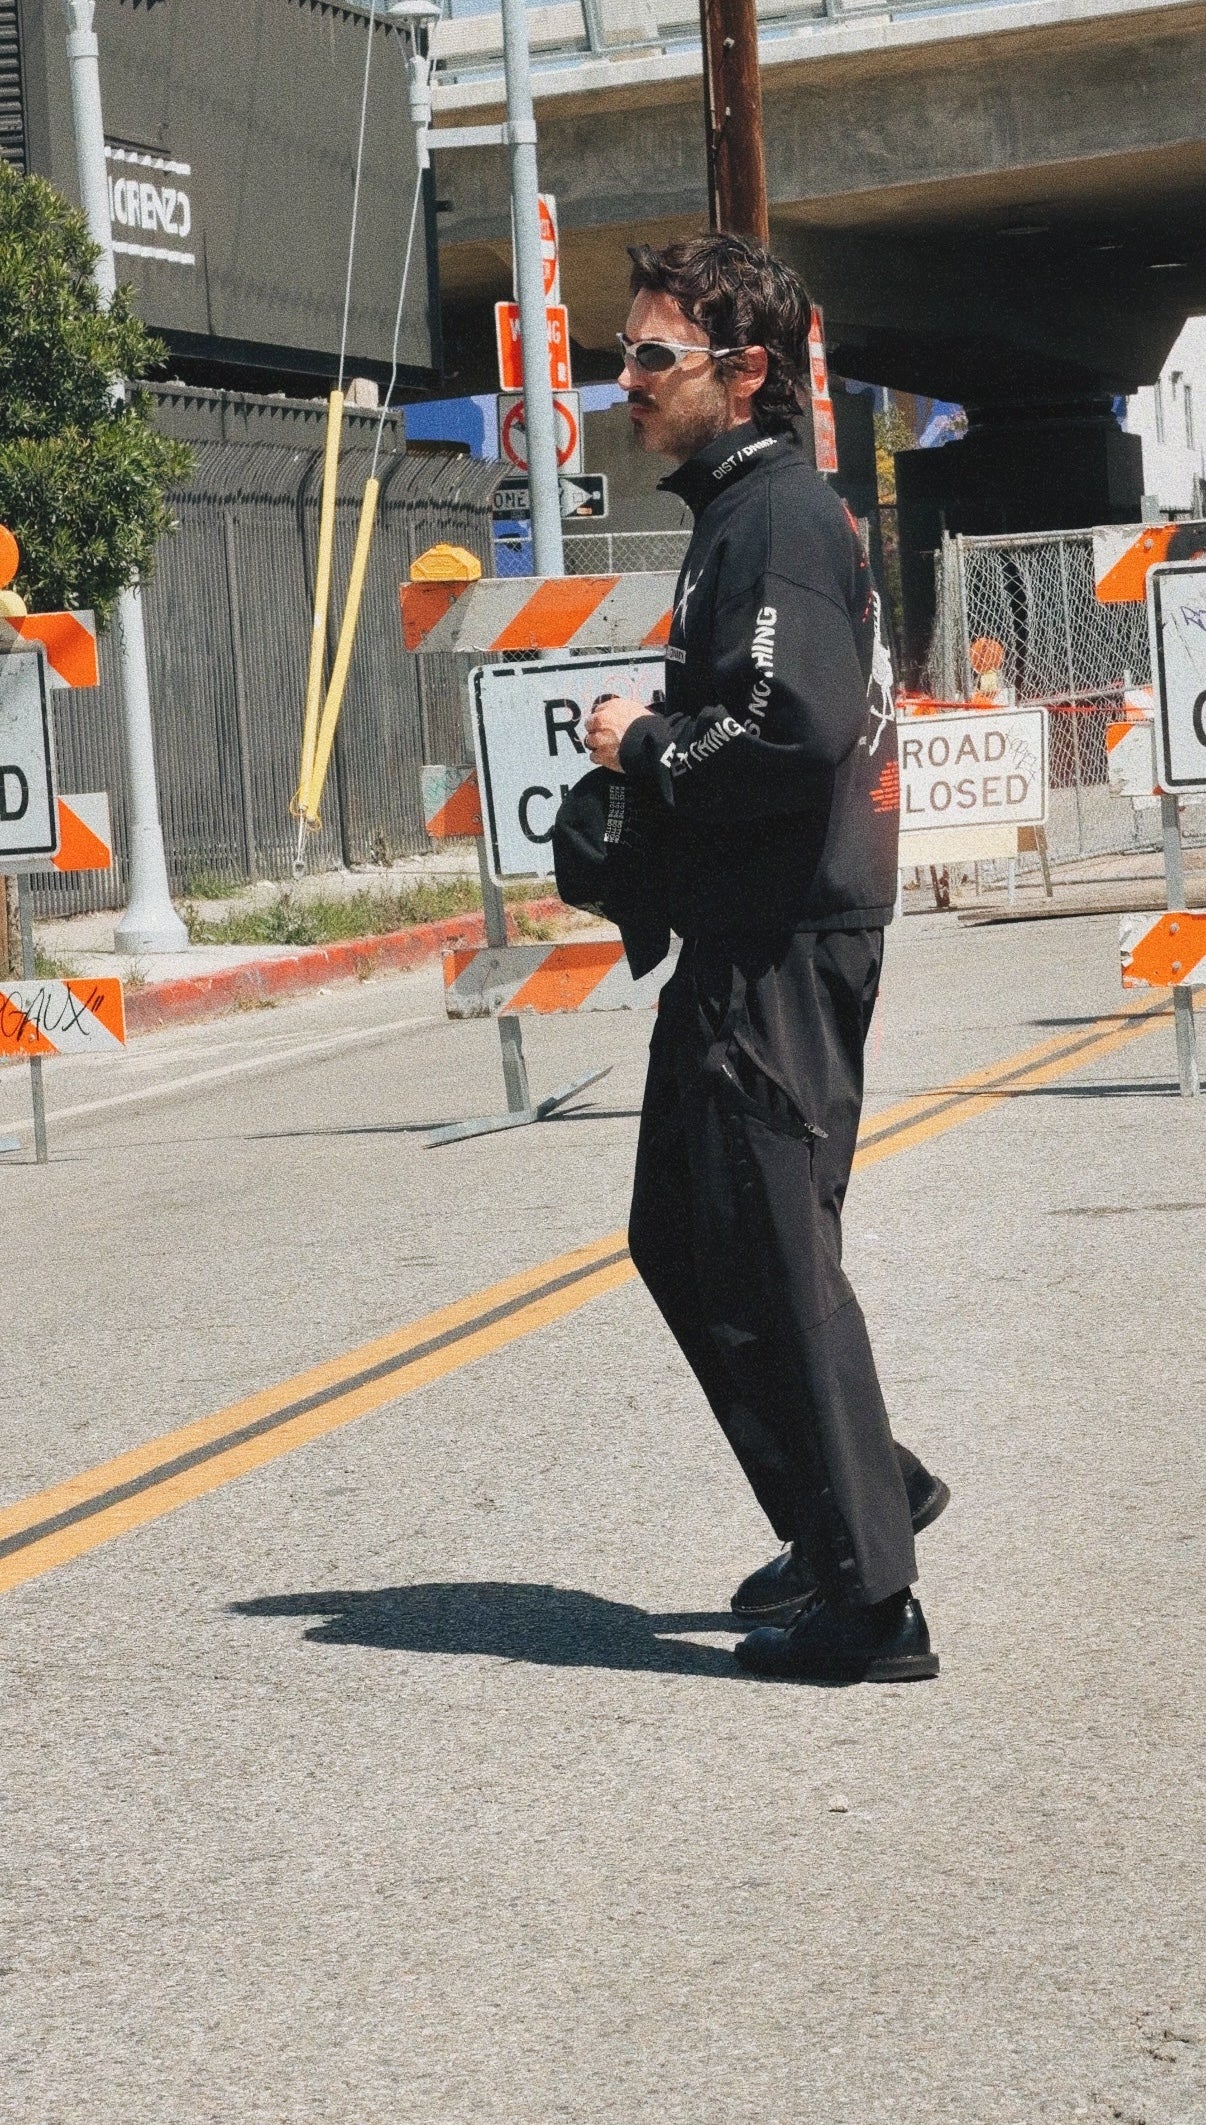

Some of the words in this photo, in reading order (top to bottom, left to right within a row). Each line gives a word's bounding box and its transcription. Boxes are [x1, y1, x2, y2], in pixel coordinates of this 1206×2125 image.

[712, 455, 737, 480] DIST
[494, 491, 526, 508] ONE
[903, 730, 1006, 770] ROAD
[905, 774, 1029, 814] LOSED
